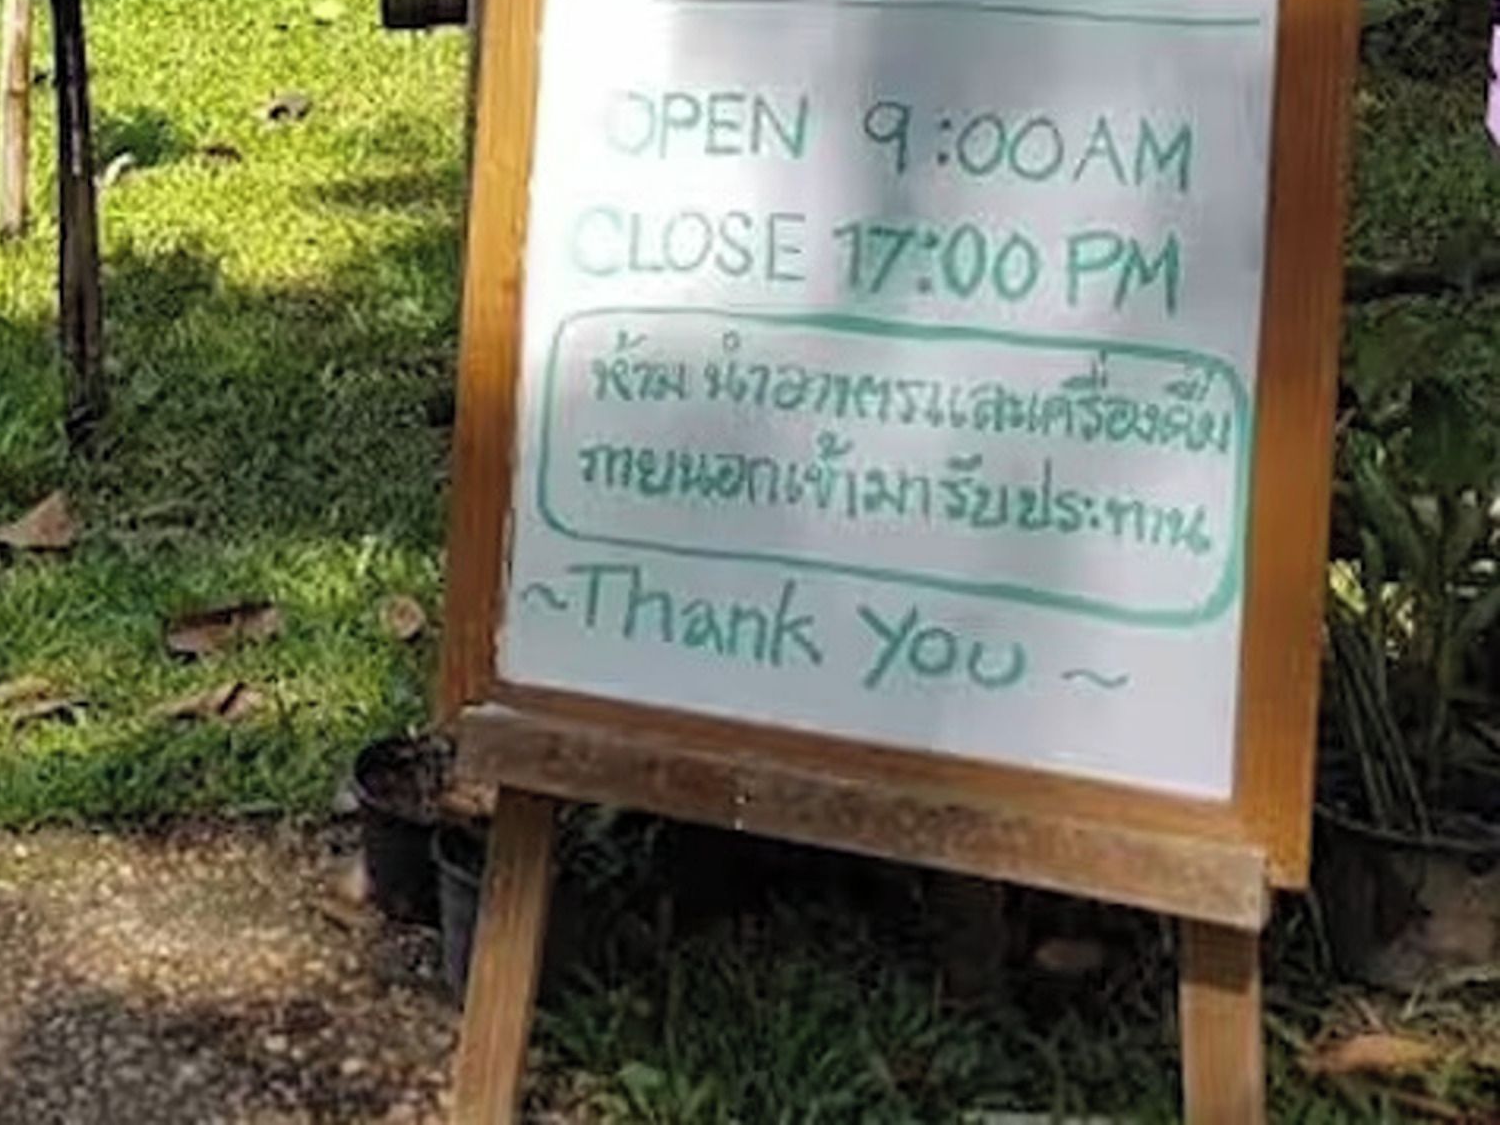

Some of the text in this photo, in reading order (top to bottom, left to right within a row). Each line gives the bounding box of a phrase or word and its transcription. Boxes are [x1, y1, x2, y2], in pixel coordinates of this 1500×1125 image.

[603, 91, 810, 159] OPEN
[572, 207, 1180, 315] CLOSE 17:00 PM
